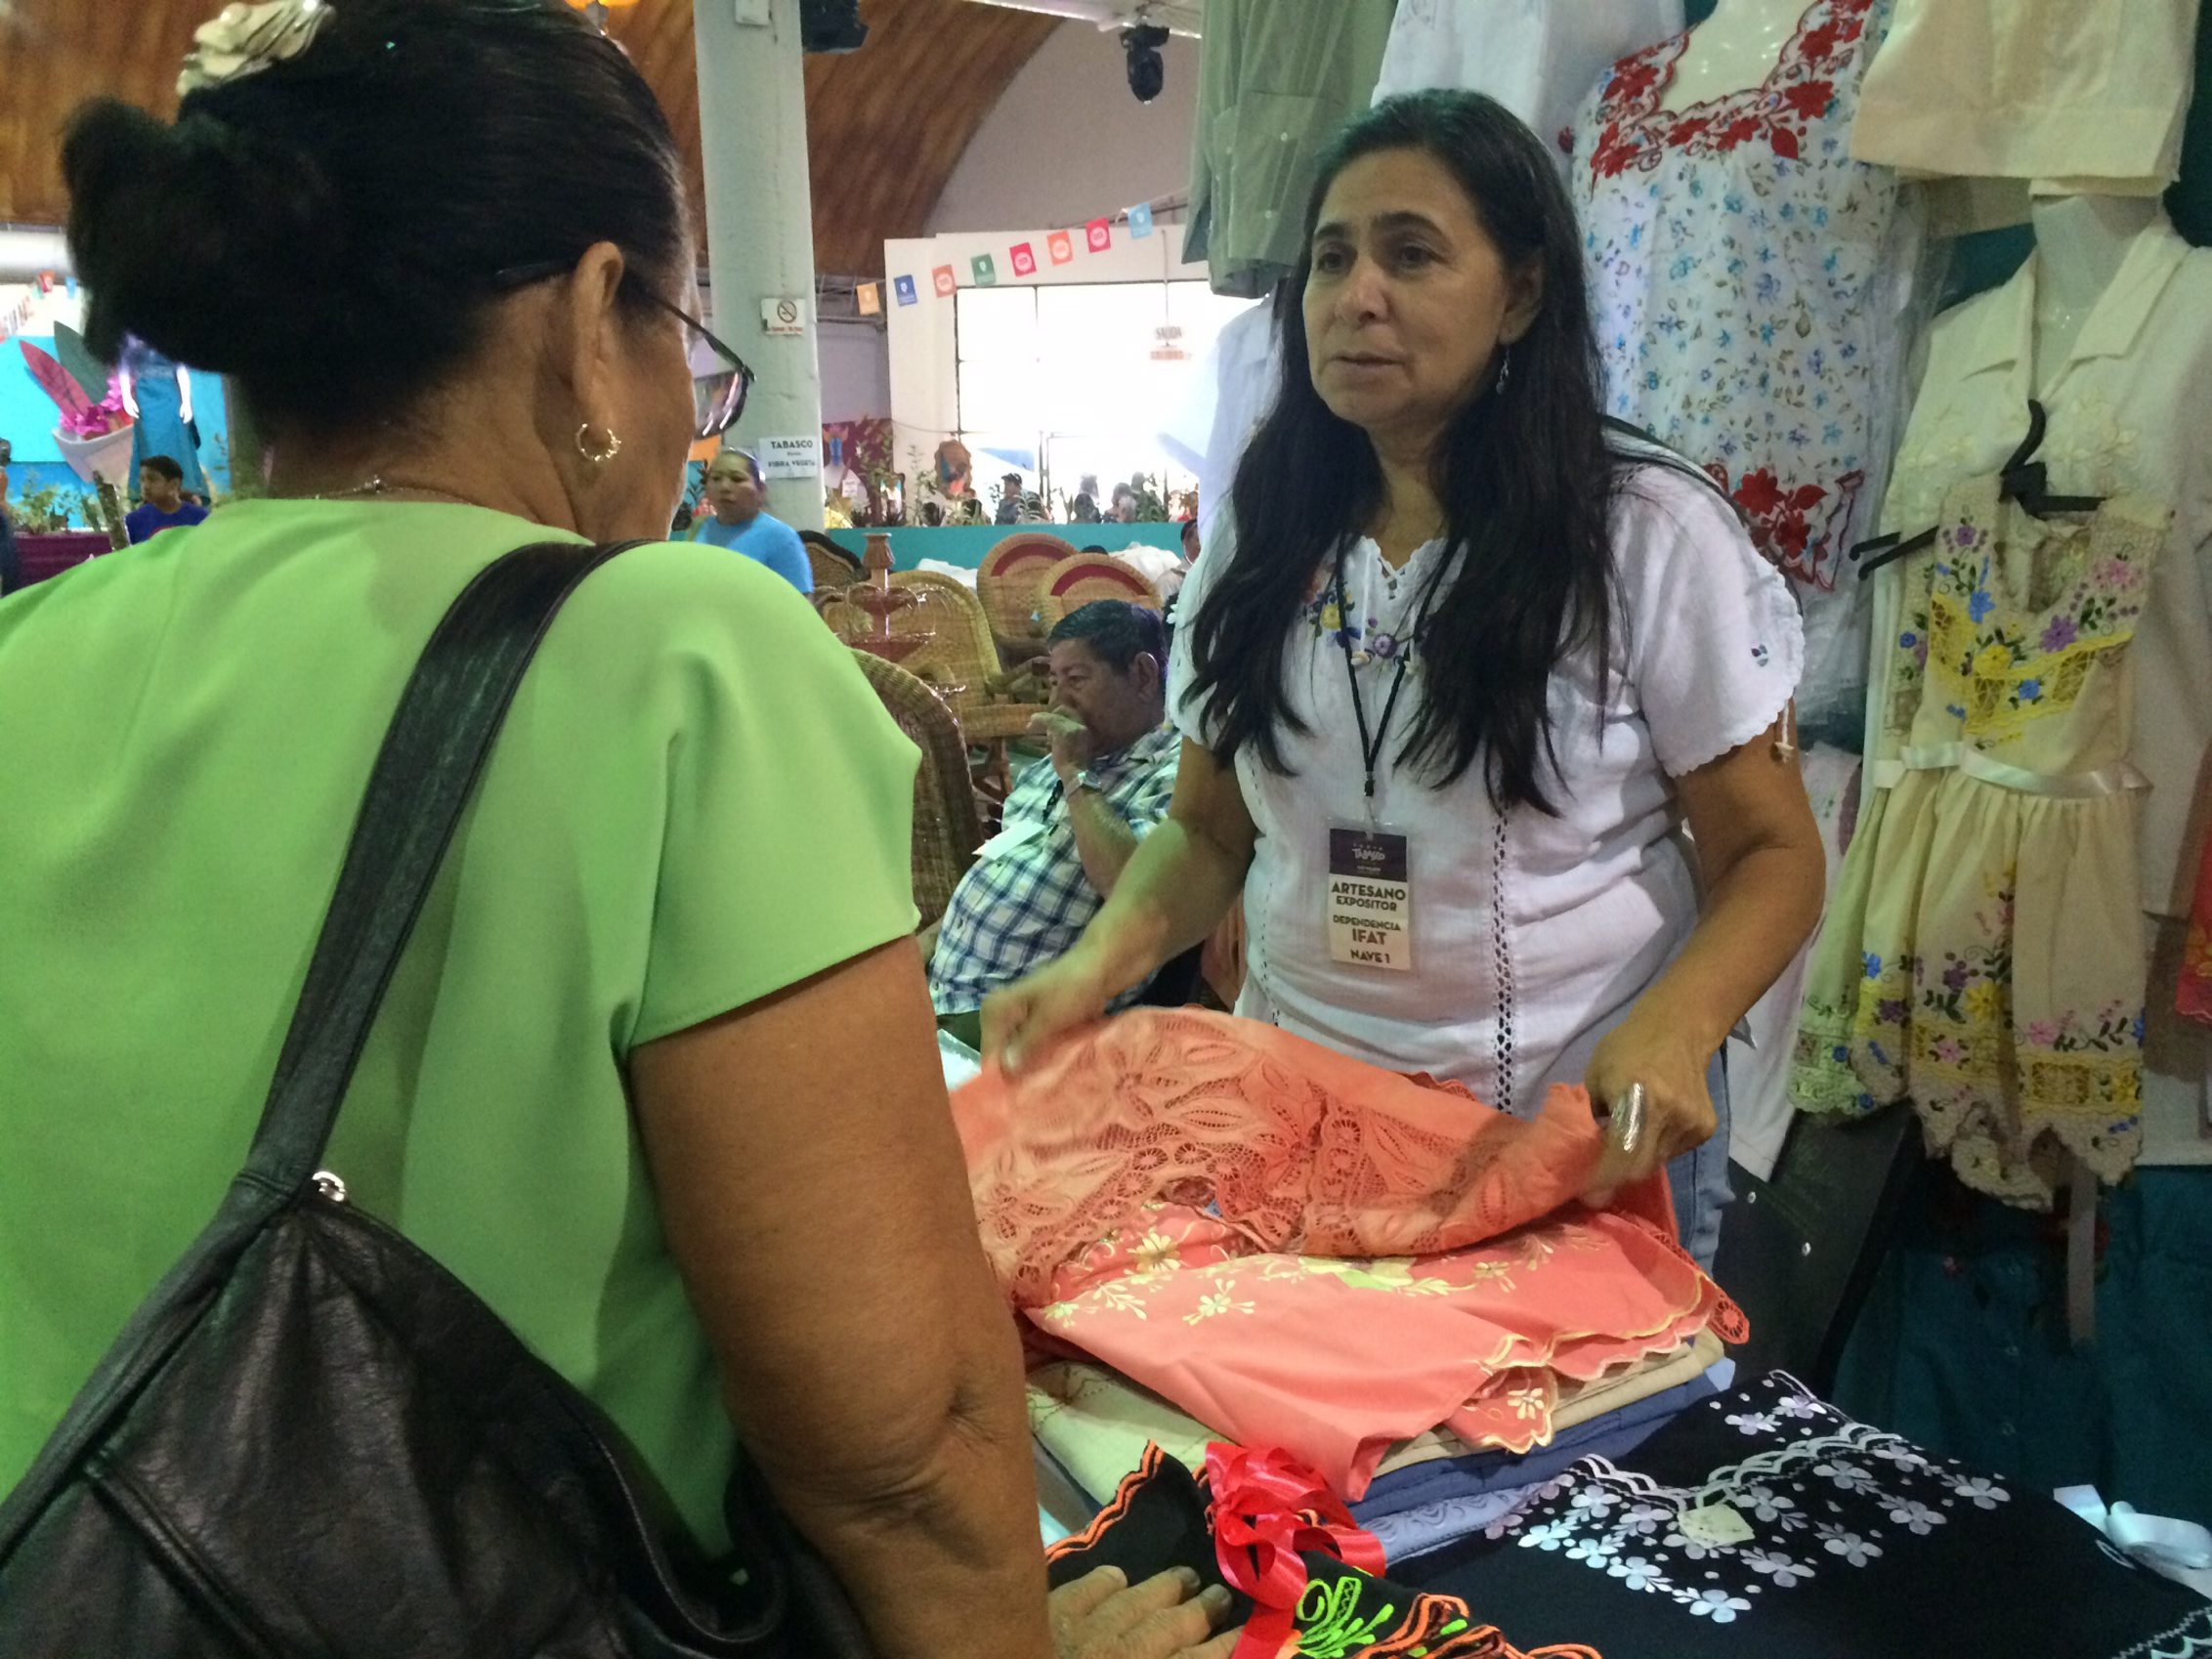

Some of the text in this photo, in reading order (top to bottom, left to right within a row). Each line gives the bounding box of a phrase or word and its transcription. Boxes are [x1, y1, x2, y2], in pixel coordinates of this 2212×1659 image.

[770, 440, 814, 449] TABASCO
[1331, 882, 1406, 901] ARTESANO
[1336, 896, 1397, 912] EXPOSITOR
[1333, 915, 1401, 931] DEPENDENCIA
[1352, 928, 1387, 946] IFAT
[1350, 949, 1390, 963] NAVE 1
